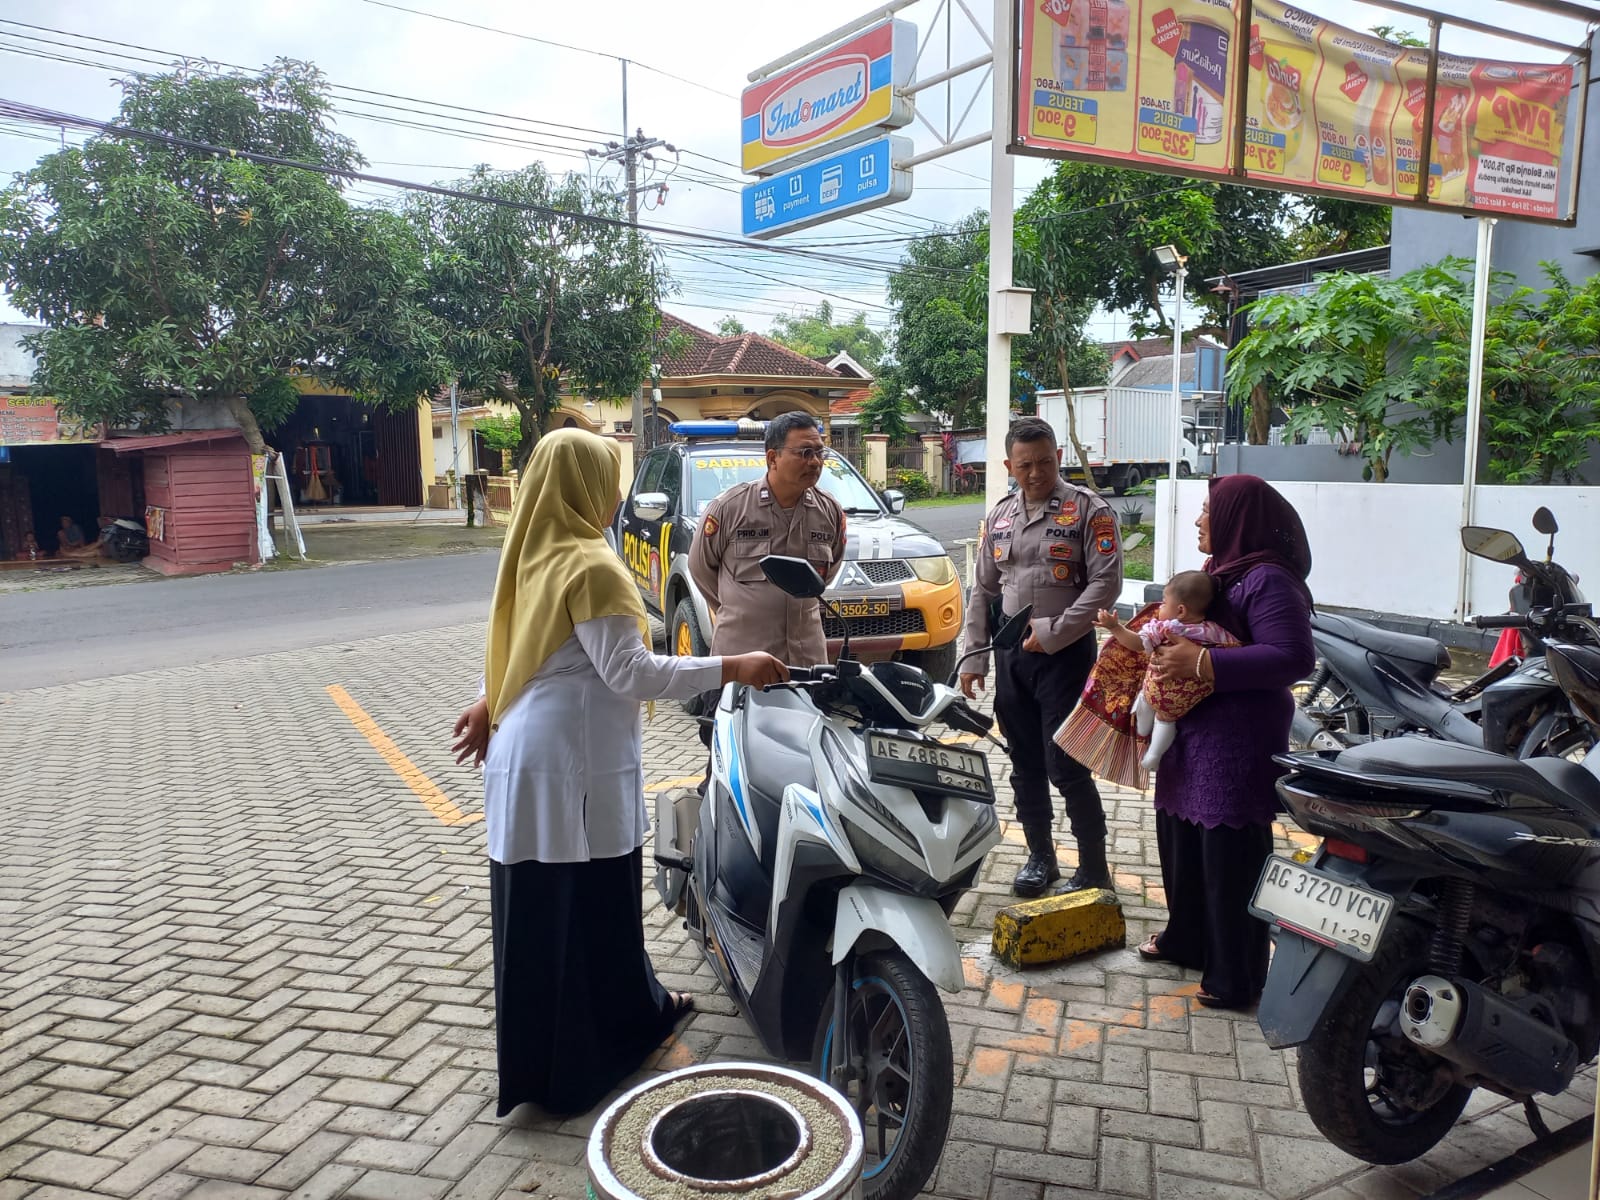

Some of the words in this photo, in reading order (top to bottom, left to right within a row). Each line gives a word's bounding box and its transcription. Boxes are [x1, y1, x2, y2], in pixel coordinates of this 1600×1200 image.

[767, 71, 862, 136] Indomaret
[755, 186, 775, 200] PAKET
[857, 178, 877, 193] pulsa
[822, 189, 838, 199] DEBIT
[783, 194, 810, 212] payment
[1046, 528, 1081, 539] POLRI
[624, 532, 651, 580] POLISI
[842, 603, 887, 616] 3502-50
[878, 740, 899, 759] AE
[908, 746, 949, 767] 4886
[1266, 864, 1292, 888] AG
[1294, 873, 1342, 907] 3720
[1346, 890, 1385, 924] VCN
